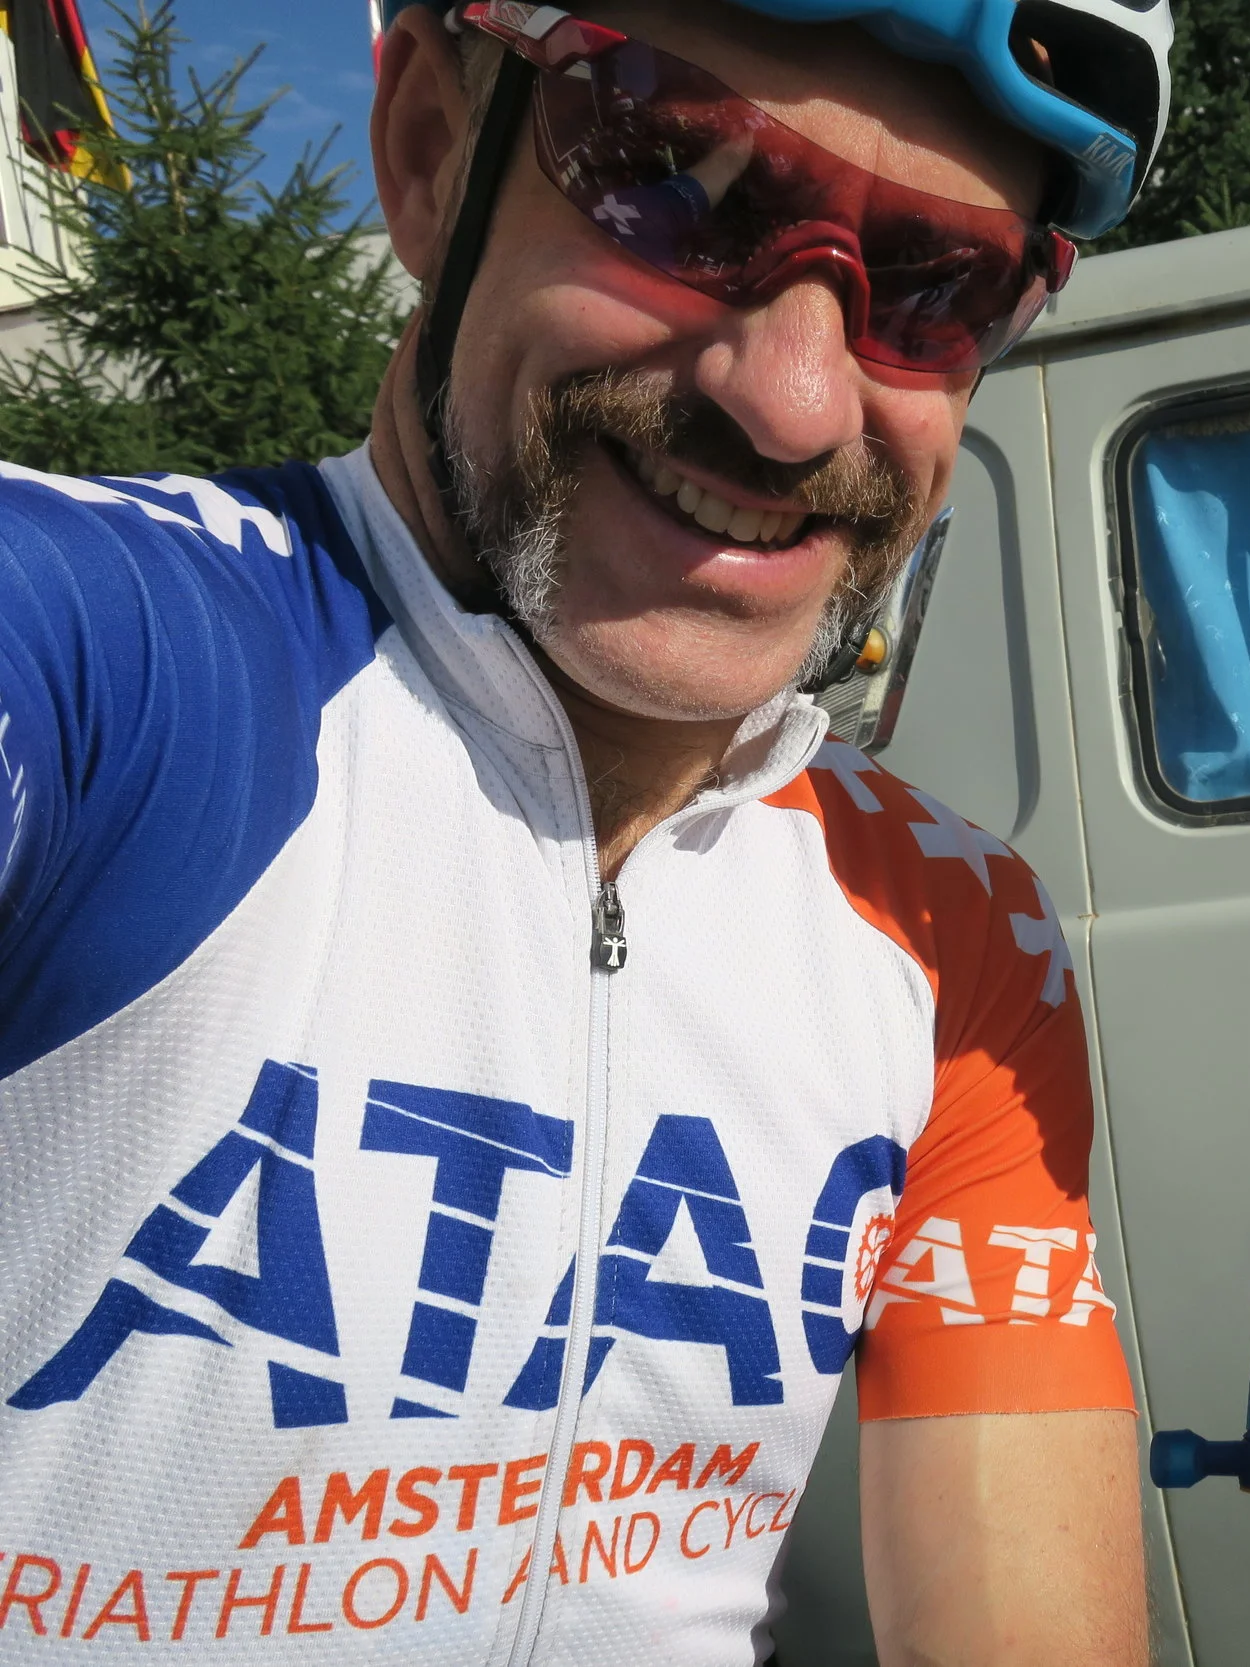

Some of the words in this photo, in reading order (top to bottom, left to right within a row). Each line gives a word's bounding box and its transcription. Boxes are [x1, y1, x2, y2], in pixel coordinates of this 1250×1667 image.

[239, 1437, 761, 1550] AMSTERDAM
[0, 1548, 481, 1643] RIATHLON
[505, 1512, 662, 1592] AND
[681, 1487, 806, 1559] CYCL
